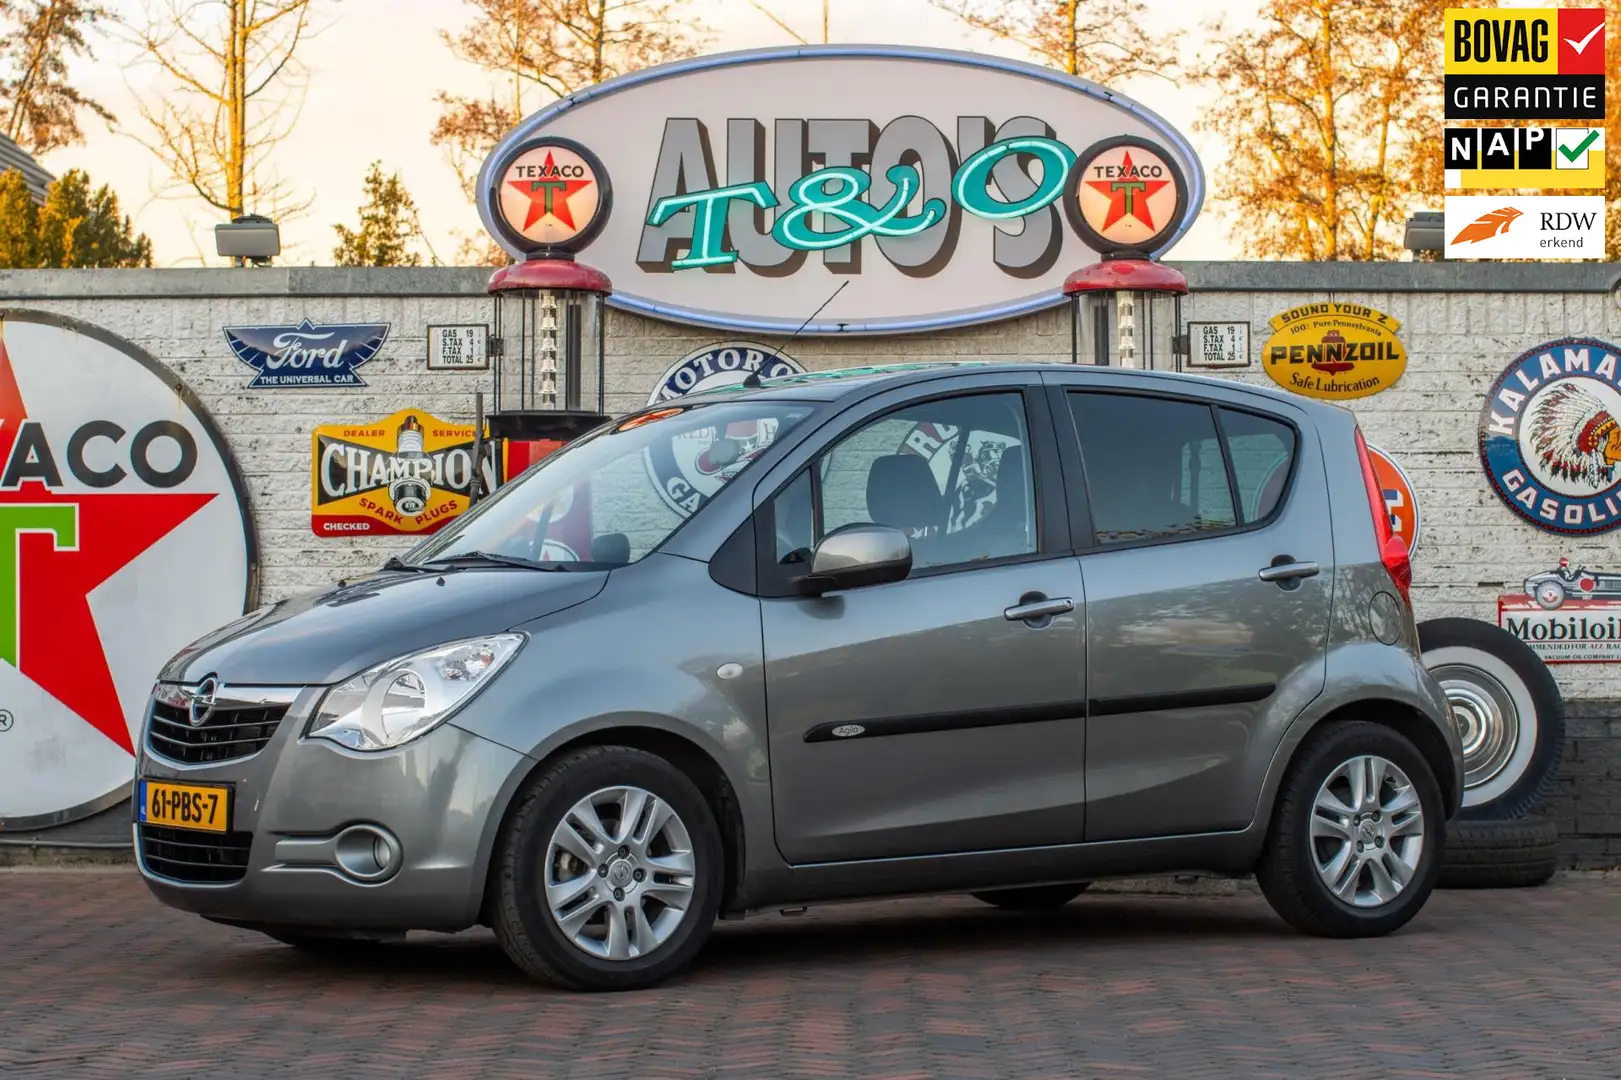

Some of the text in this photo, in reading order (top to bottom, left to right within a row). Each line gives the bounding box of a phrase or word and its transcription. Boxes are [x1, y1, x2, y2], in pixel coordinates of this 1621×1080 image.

[515, 165, 584, 178] TEXACO
[1093, 165, 1162, 178] TEXACO
[531, 181, 566, 214] T
[636, 115, 1063, 279] AUTO'S
[1111, 181, 1146, 215] T
[1281, 304, 1388, 324] SOUND YOUR Z
[442, 329, 474, 338] GAS 19
[1203, 326, 1235, 335] GAS 19
[1313, 320, 1332, 329] Pure
[1333, 319, 1382, 337] Pennsylvania
[266, 331, 348, 370] Ford
[442, 356, 474, 364] TOTAL 25
[1203, 352, 1236, 361] TOTAL 25
[1270, 342, 1400, 365] PENNZOIL
[260, 375, 354, 384] THE UNIVERSAL CAR
[1290, 372, 1380, 392] Safe Lubrication
[1488, 348, 1621, 435] KALAMA
[343, 429, 386, 437] DEALER
[1502, 469, 1621, 525] GASOLI
[359, 497, 458, 525] SPARK PLUGS
[323, 522, 370, 531] CHECKED
[152, 788, 219, 824] 61-PBS-7
